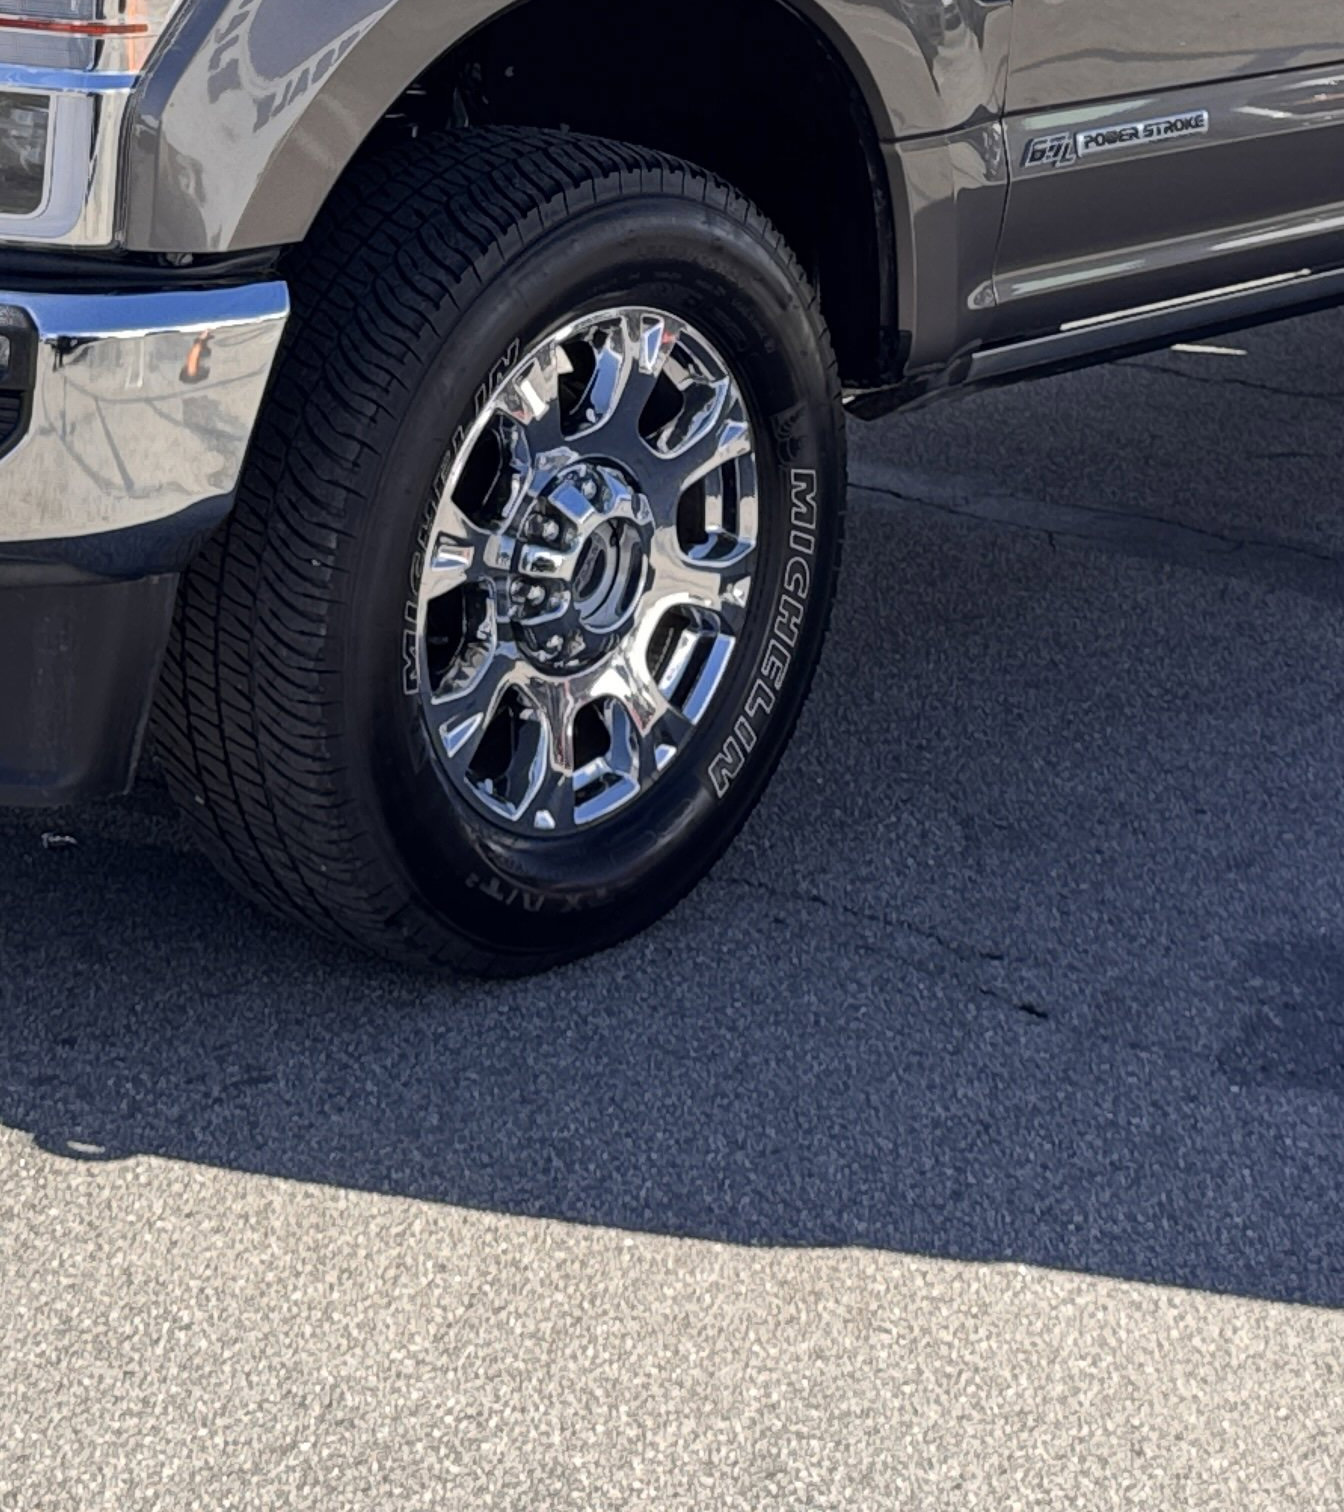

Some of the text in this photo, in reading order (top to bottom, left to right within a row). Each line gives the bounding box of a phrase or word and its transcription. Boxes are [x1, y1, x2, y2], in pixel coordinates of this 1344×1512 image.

[1083, 125, 1140, 150] POWER
[1142, 111, 1205, 138] STROKE
[708, 468, 819, 799] MICHELIN
